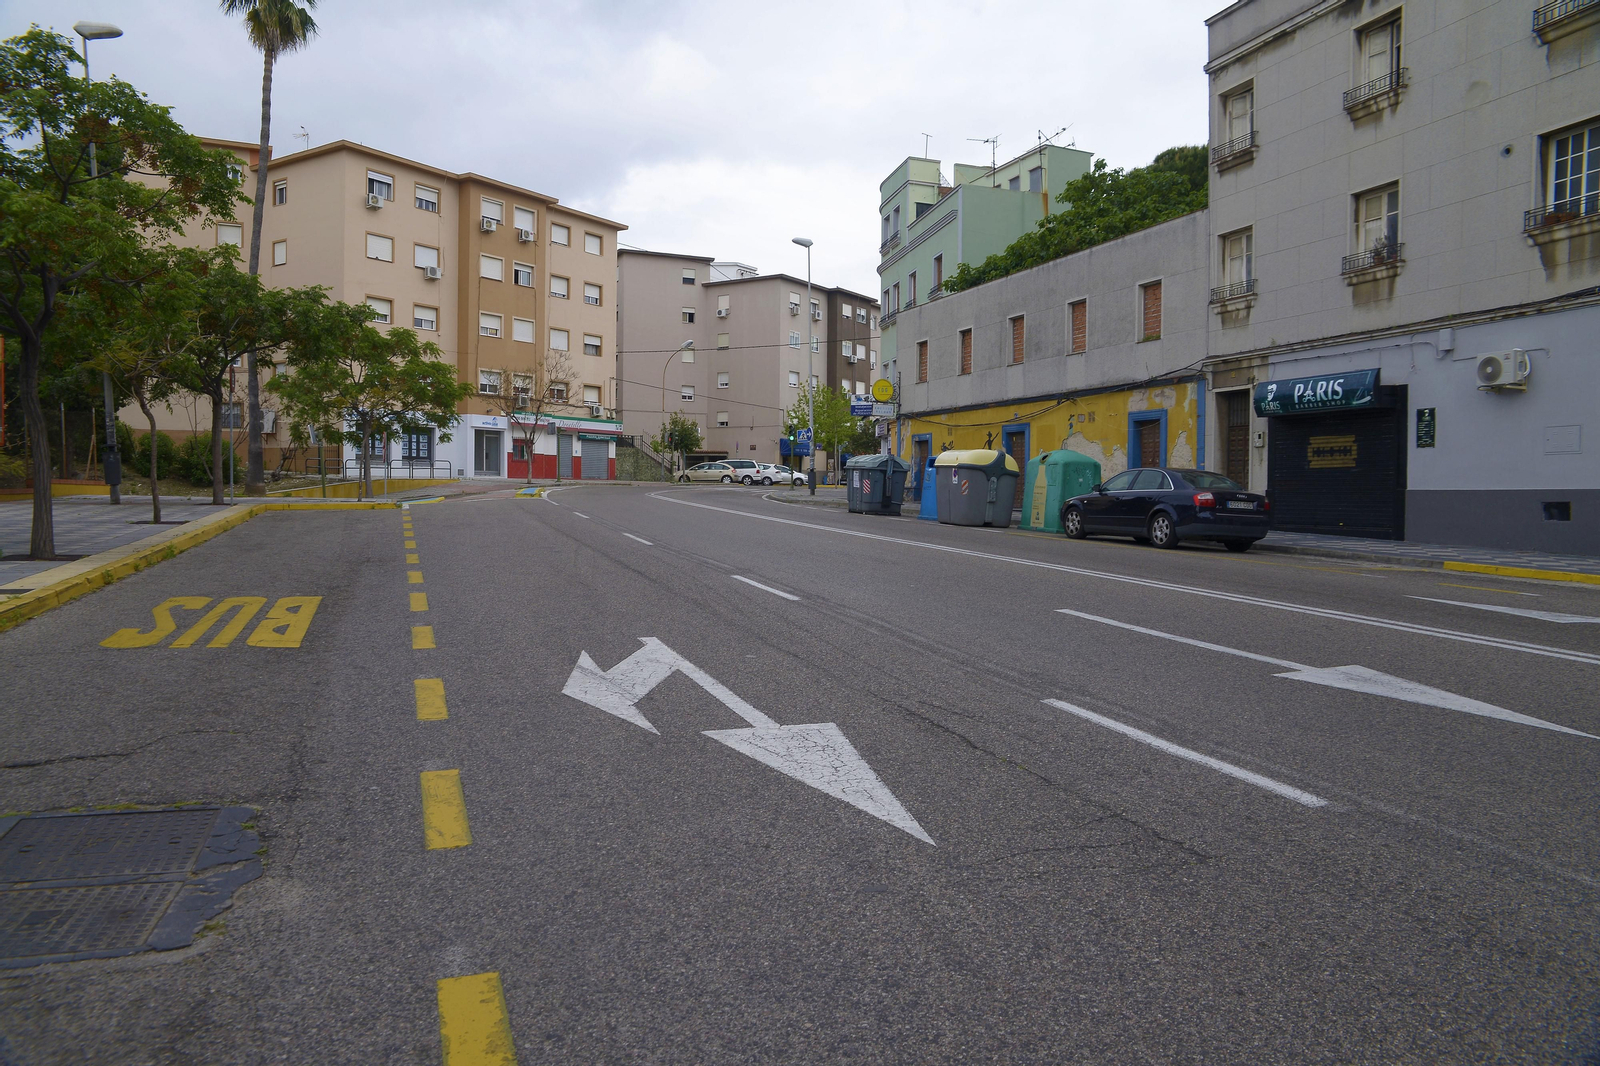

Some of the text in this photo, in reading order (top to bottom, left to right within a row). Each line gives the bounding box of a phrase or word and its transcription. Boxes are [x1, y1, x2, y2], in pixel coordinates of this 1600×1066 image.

[1294, 379, 1344, 403] PARIS
[1261, 400, 1280, 411] PARIS
[99, 596, 322, 648] BUS
